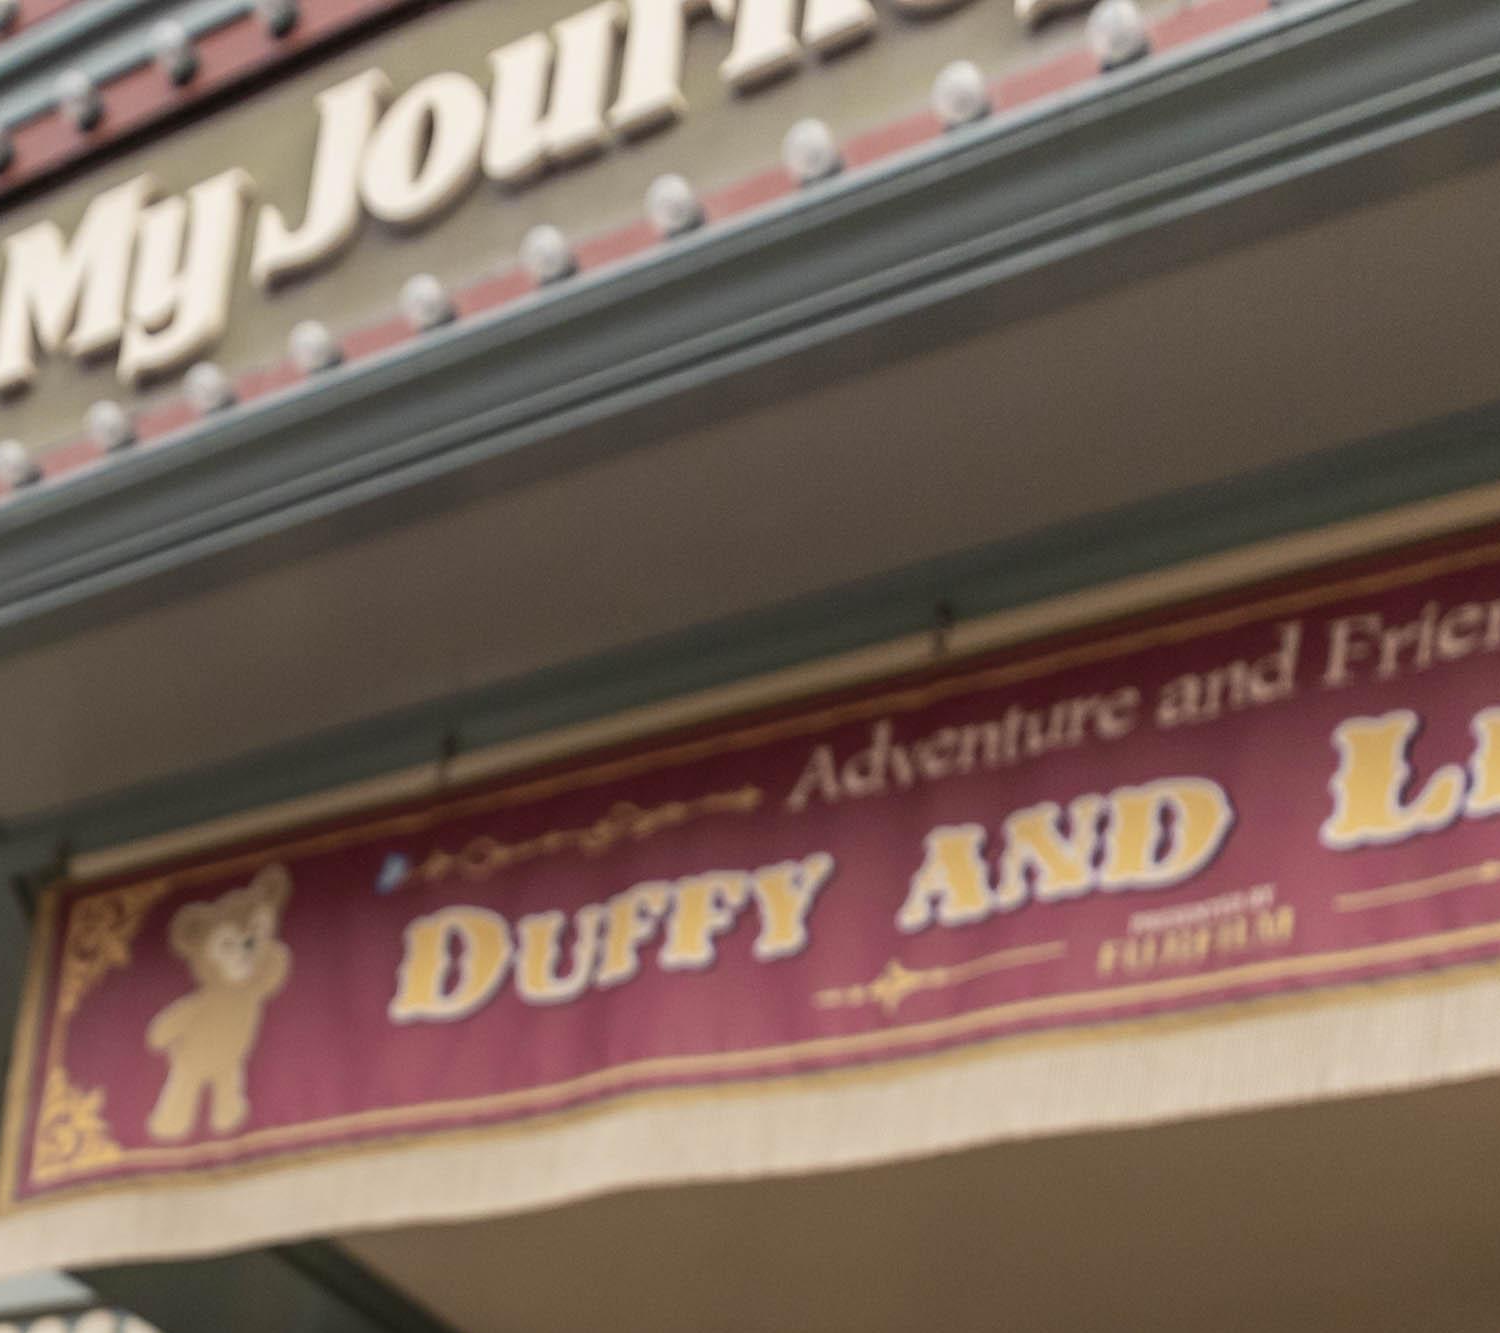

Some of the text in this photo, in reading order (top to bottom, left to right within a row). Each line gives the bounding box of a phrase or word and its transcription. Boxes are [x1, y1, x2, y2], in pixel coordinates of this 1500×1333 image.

[787, 676, 1140, 812] Adventure
[1156, 622, 1304, 730] and
[897, 777, 1236, 930] AND
